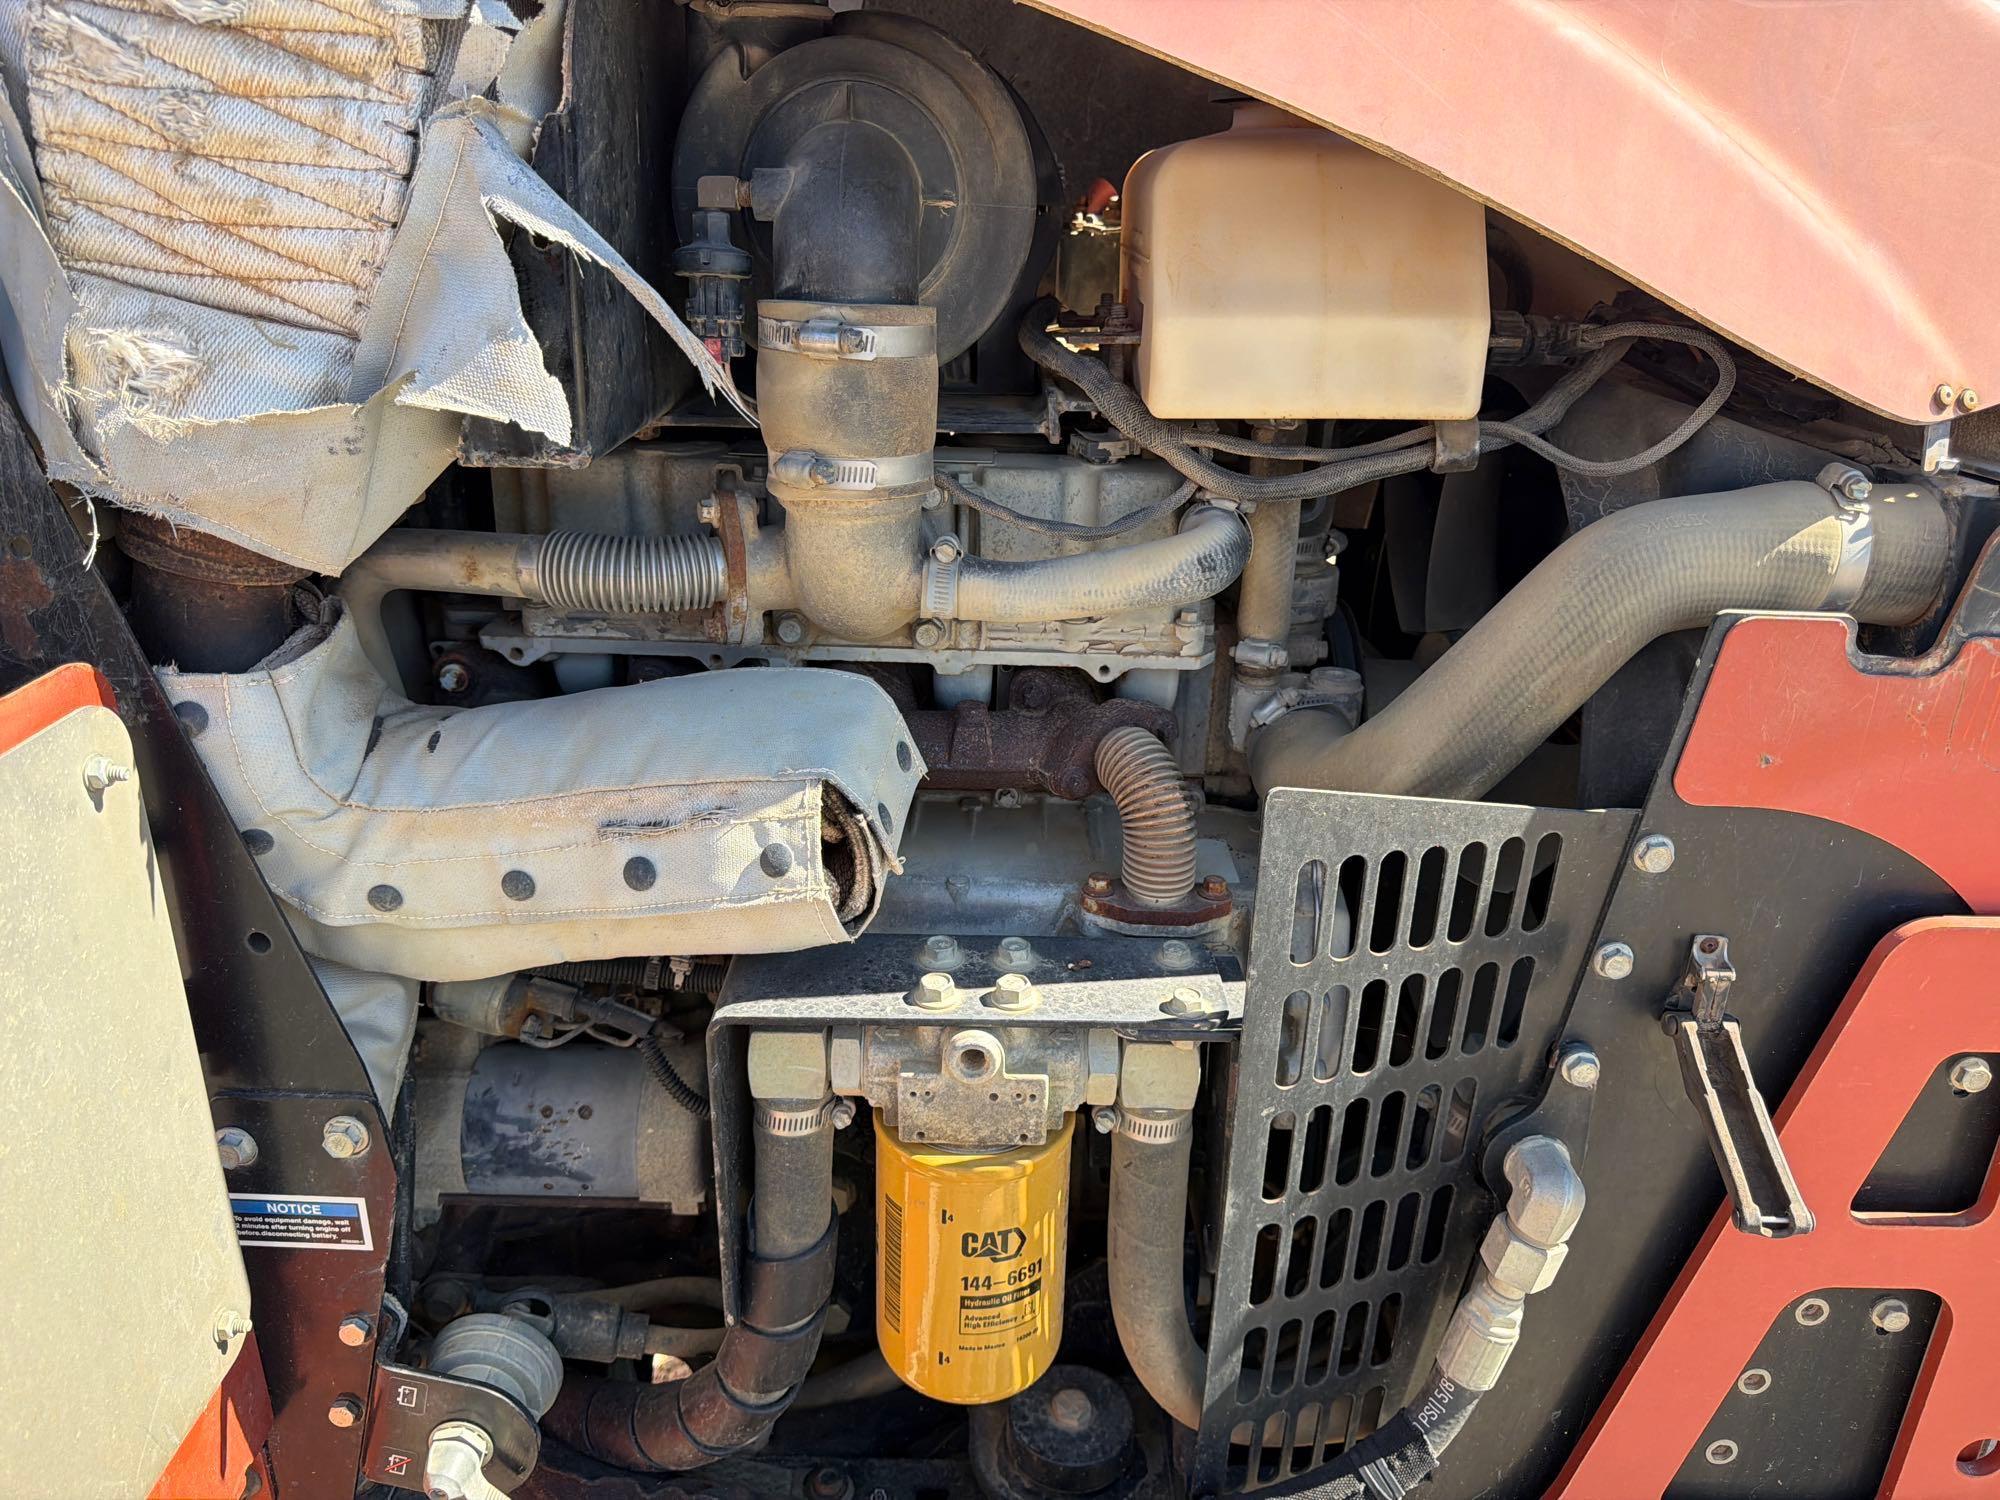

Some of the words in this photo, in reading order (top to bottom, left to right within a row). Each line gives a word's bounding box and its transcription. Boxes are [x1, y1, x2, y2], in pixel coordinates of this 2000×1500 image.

[266, 1203, 322, 1215] NOTICE
[303, 1218, 334, 1226] damage,
[261, 1230, 310, 1239] disconnecting
[311, 1232, 339, 1240] battery.
[961, 1227, 1015, 1258] CAT
[961, 1257, 1042, 1292] 144-6691
[964, 1296, 1000, 1307] Hydraulic
[1001, 1293, 1012, 1303] Oil
[1013, 1288, 1031, 1301] Filter
[964, 1312, 1001, 1321] Advanced
[964, 1321, 981, 1330] High
[982, 1316, 1018, 1328] Efficiency
